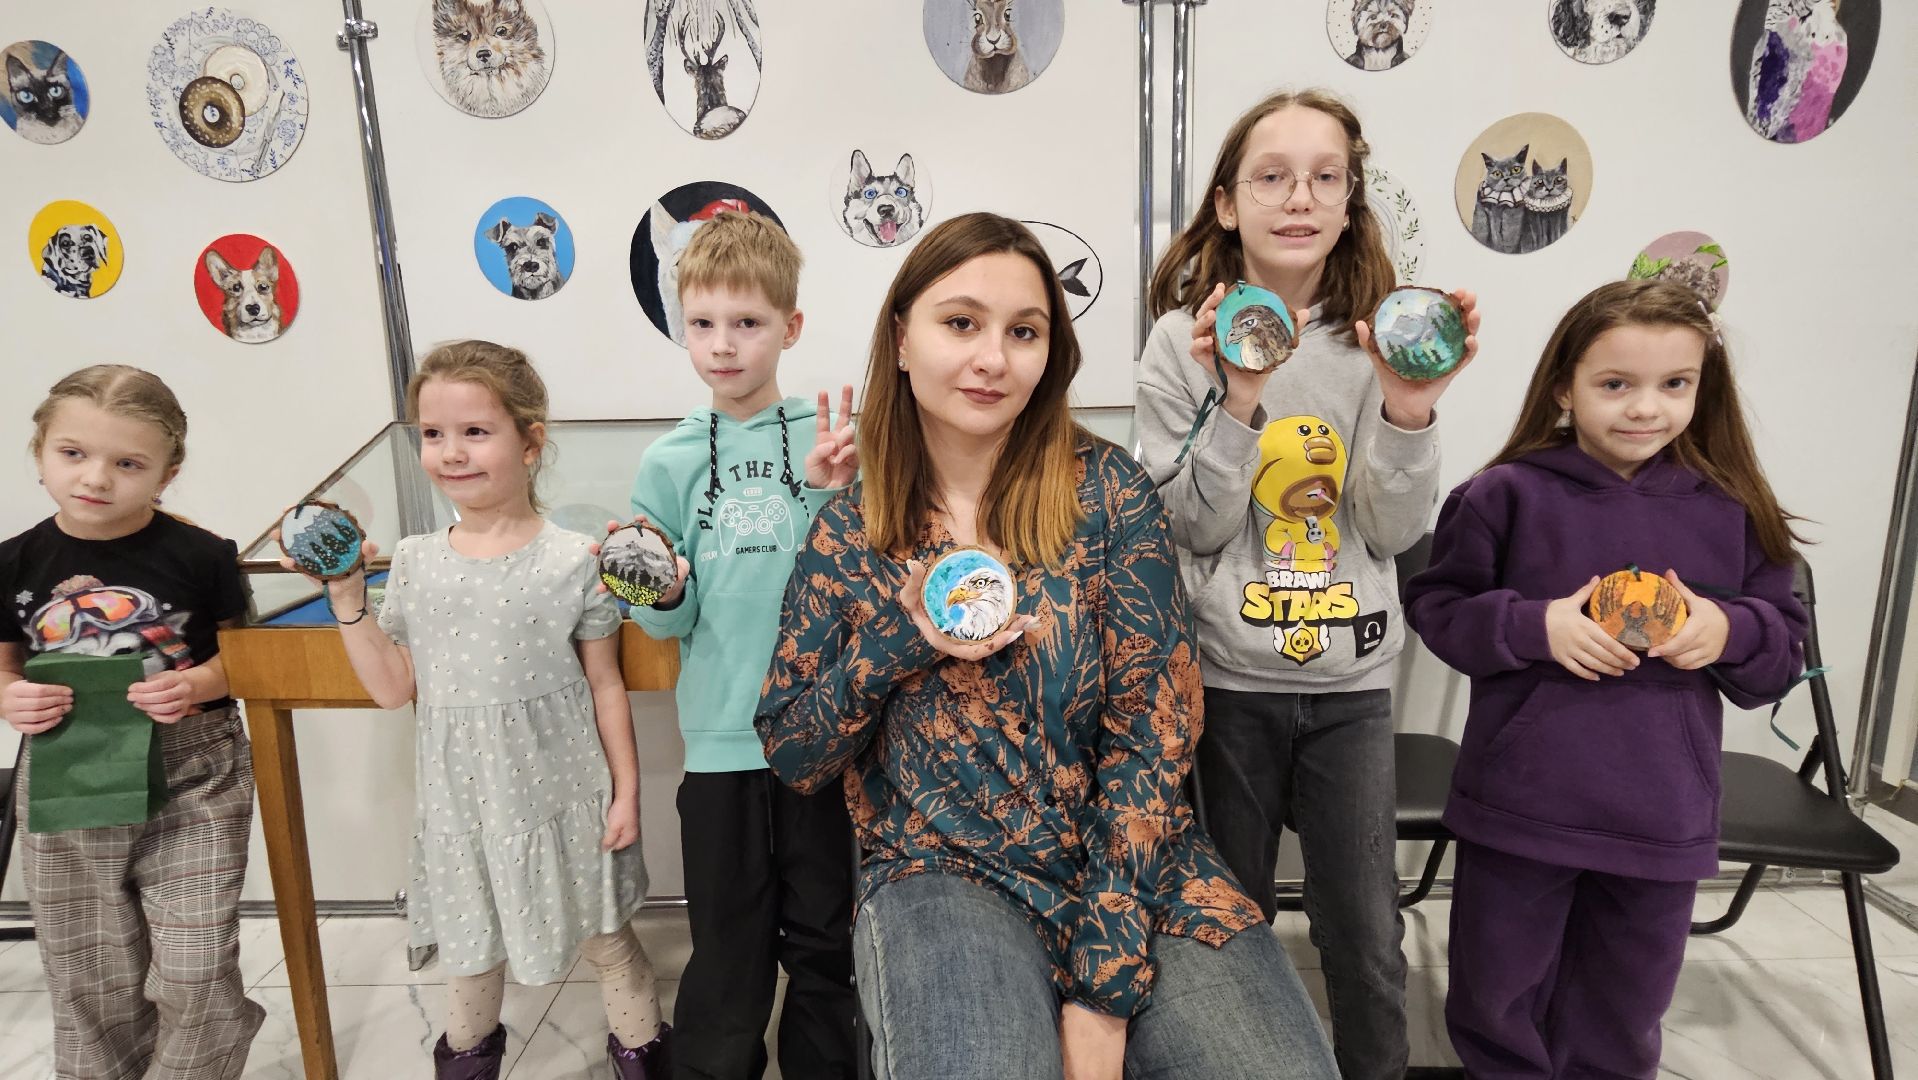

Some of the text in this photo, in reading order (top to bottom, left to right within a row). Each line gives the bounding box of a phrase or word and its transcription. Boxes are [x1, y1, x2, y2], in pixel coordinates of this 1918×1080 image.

[728, 460, 774, 482] THE
[735, 544, 777, 555] GAMERS CLUB
[1240, 582, 1359, 625] STARS
